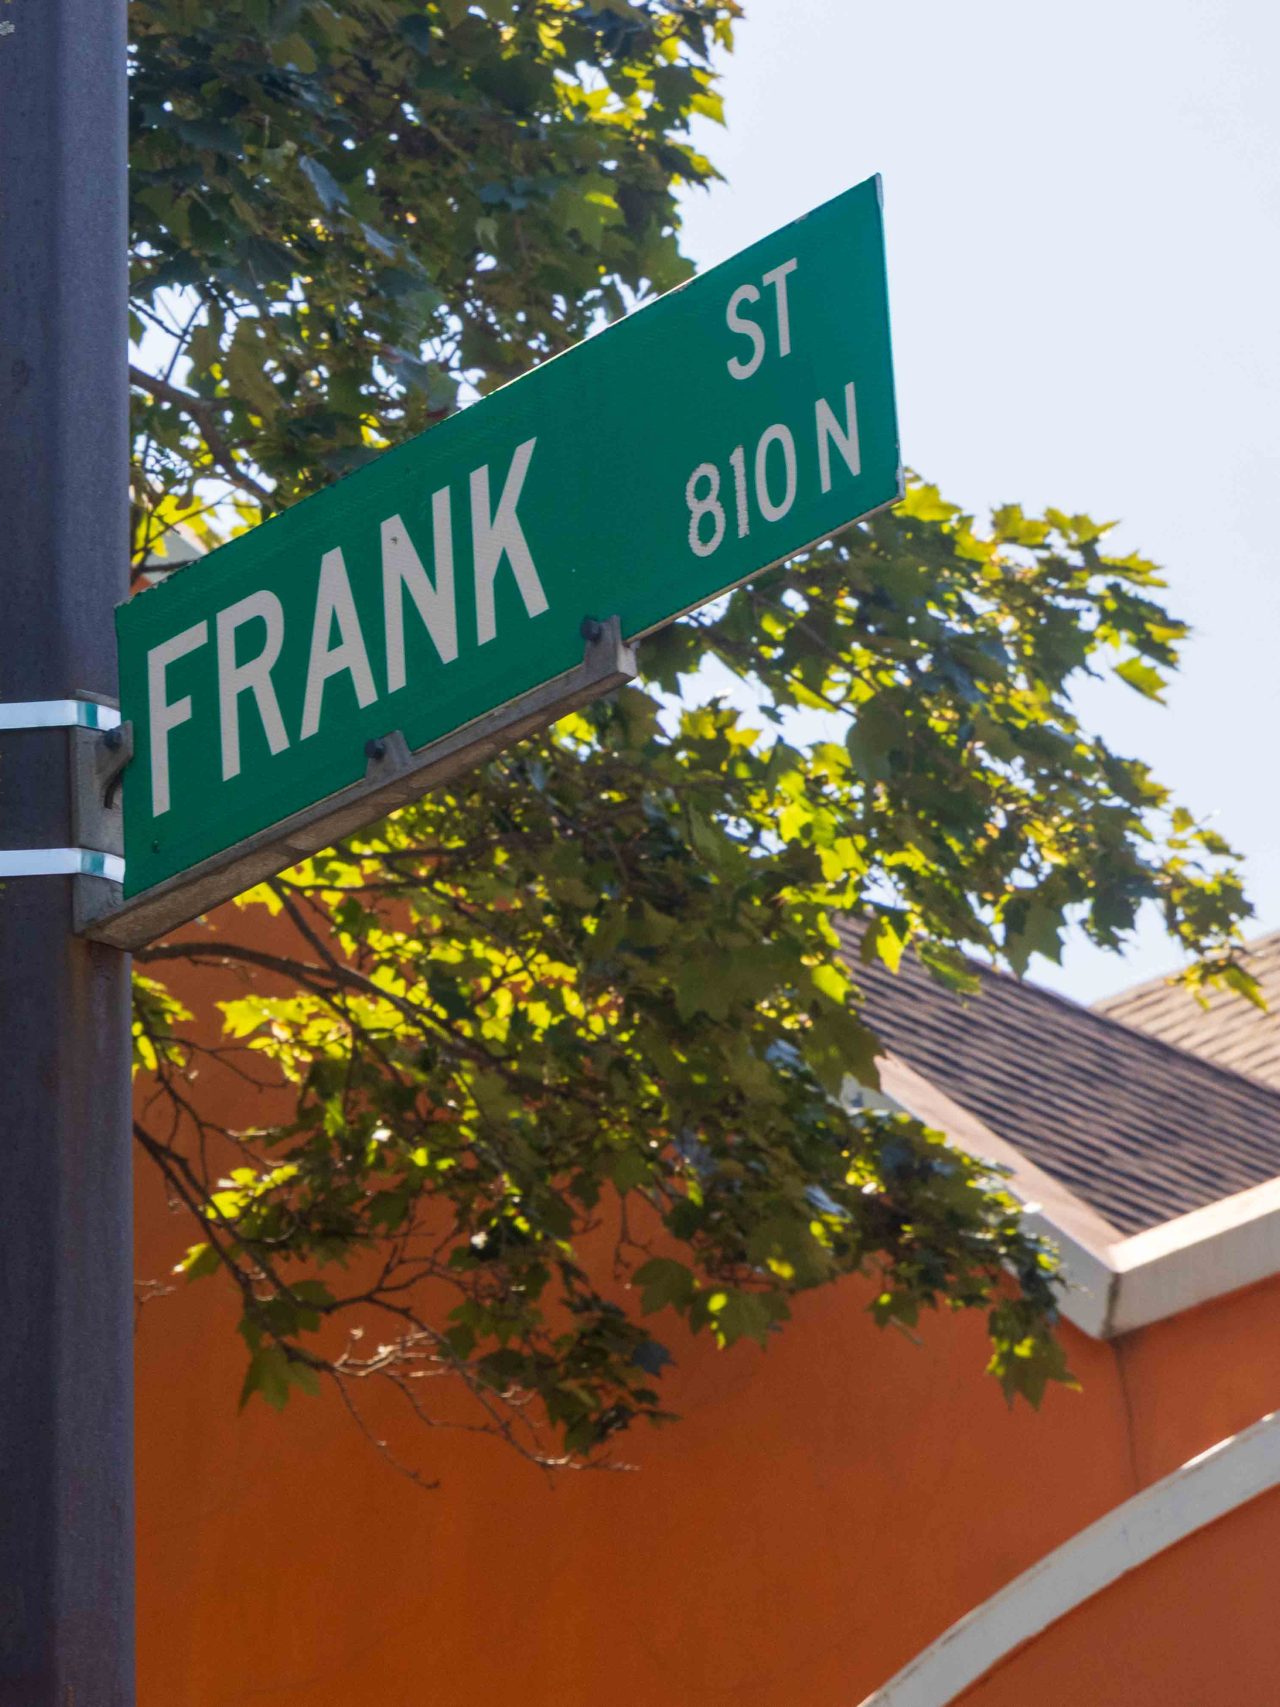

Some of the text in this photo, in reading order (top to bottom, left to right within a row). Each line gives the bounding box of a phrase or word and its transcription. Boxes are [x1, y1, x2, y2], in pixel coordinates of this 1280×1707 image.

[725, 256, 799, 381] ST
[684, 380, 862, 558] 810 N
[146, 436, 550, 819] FRANK
